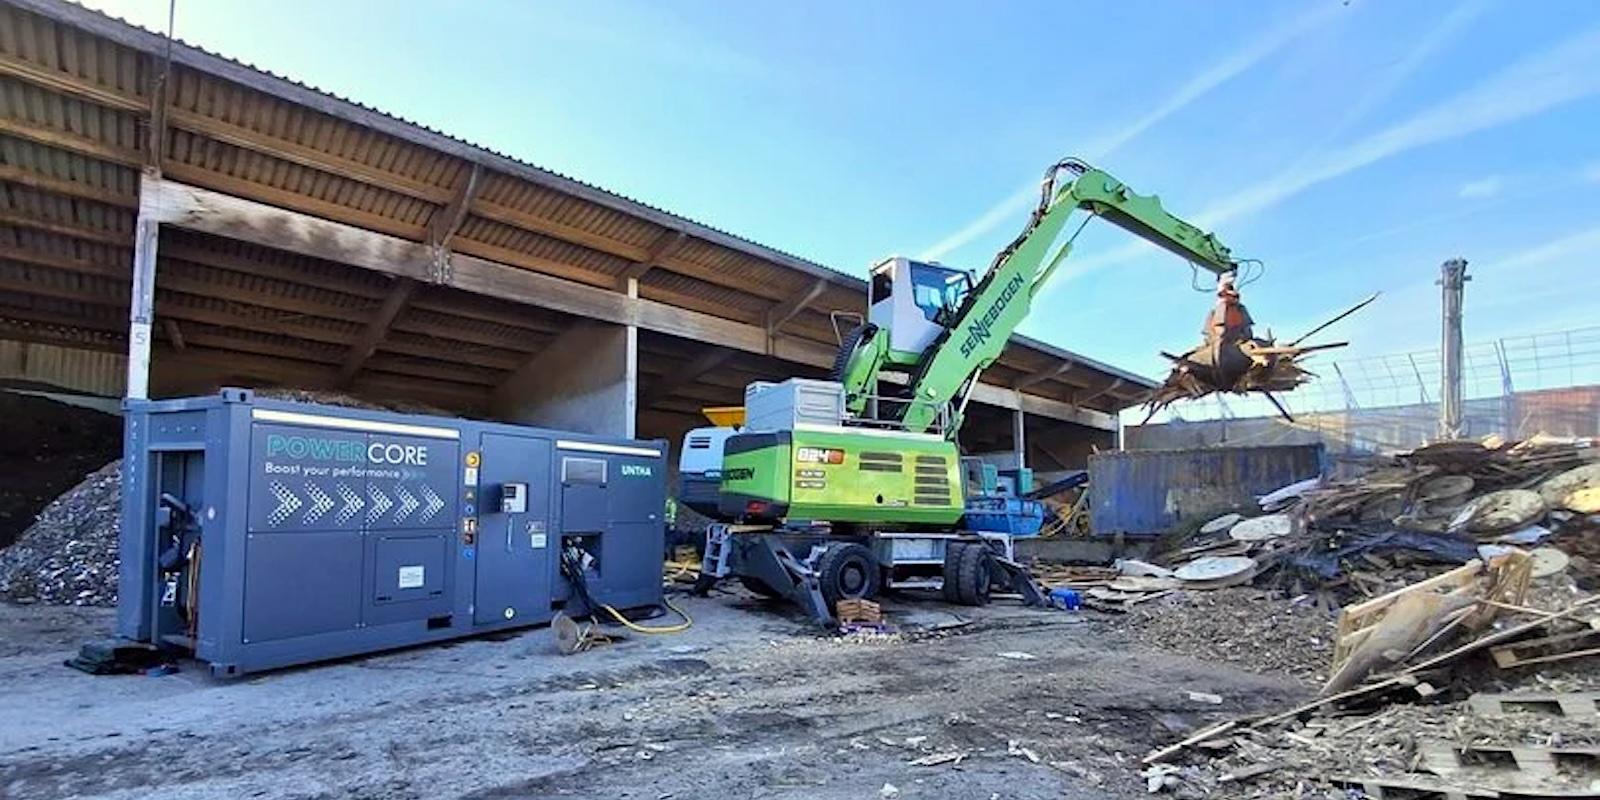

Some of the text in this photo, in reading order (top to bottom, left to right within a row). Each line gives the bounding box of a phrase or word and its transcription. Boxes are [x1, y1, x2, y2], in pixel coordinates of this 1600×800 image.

[960, 272, 1025, 358] SENNEBOGEN
[265, 462, 400, 479] Boost your performance
[621, 464, 651, 476] UNTHA
